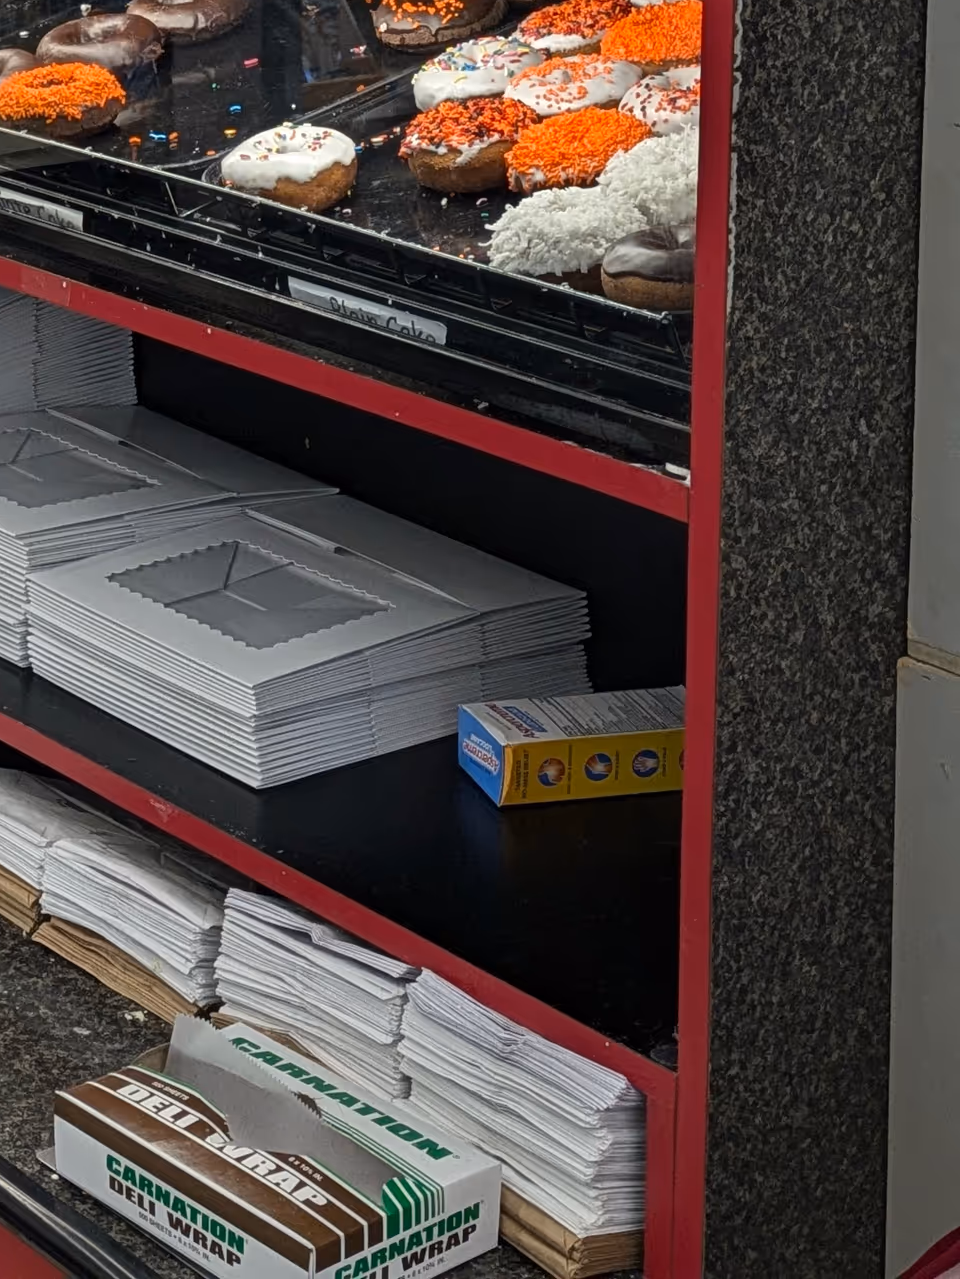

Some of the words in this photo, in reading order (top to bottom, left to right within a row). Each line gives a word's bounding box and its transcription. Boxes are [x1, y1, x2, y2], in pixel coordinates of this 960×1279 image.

[116, 1084, 199, 1128] DELI
[205, 1132, 328, 1207] WRAP
[231, 1037, 453, 1161] CARNATION
[107, 1154, 244, 1254] CARNATION
[109, 1175, 155, 1216] DELI
[167, 1210, 241, 1266] WRAP
[335, 1202, 480, 1279] CARNATION
[402, 1224, 477, 1271] WRAP
